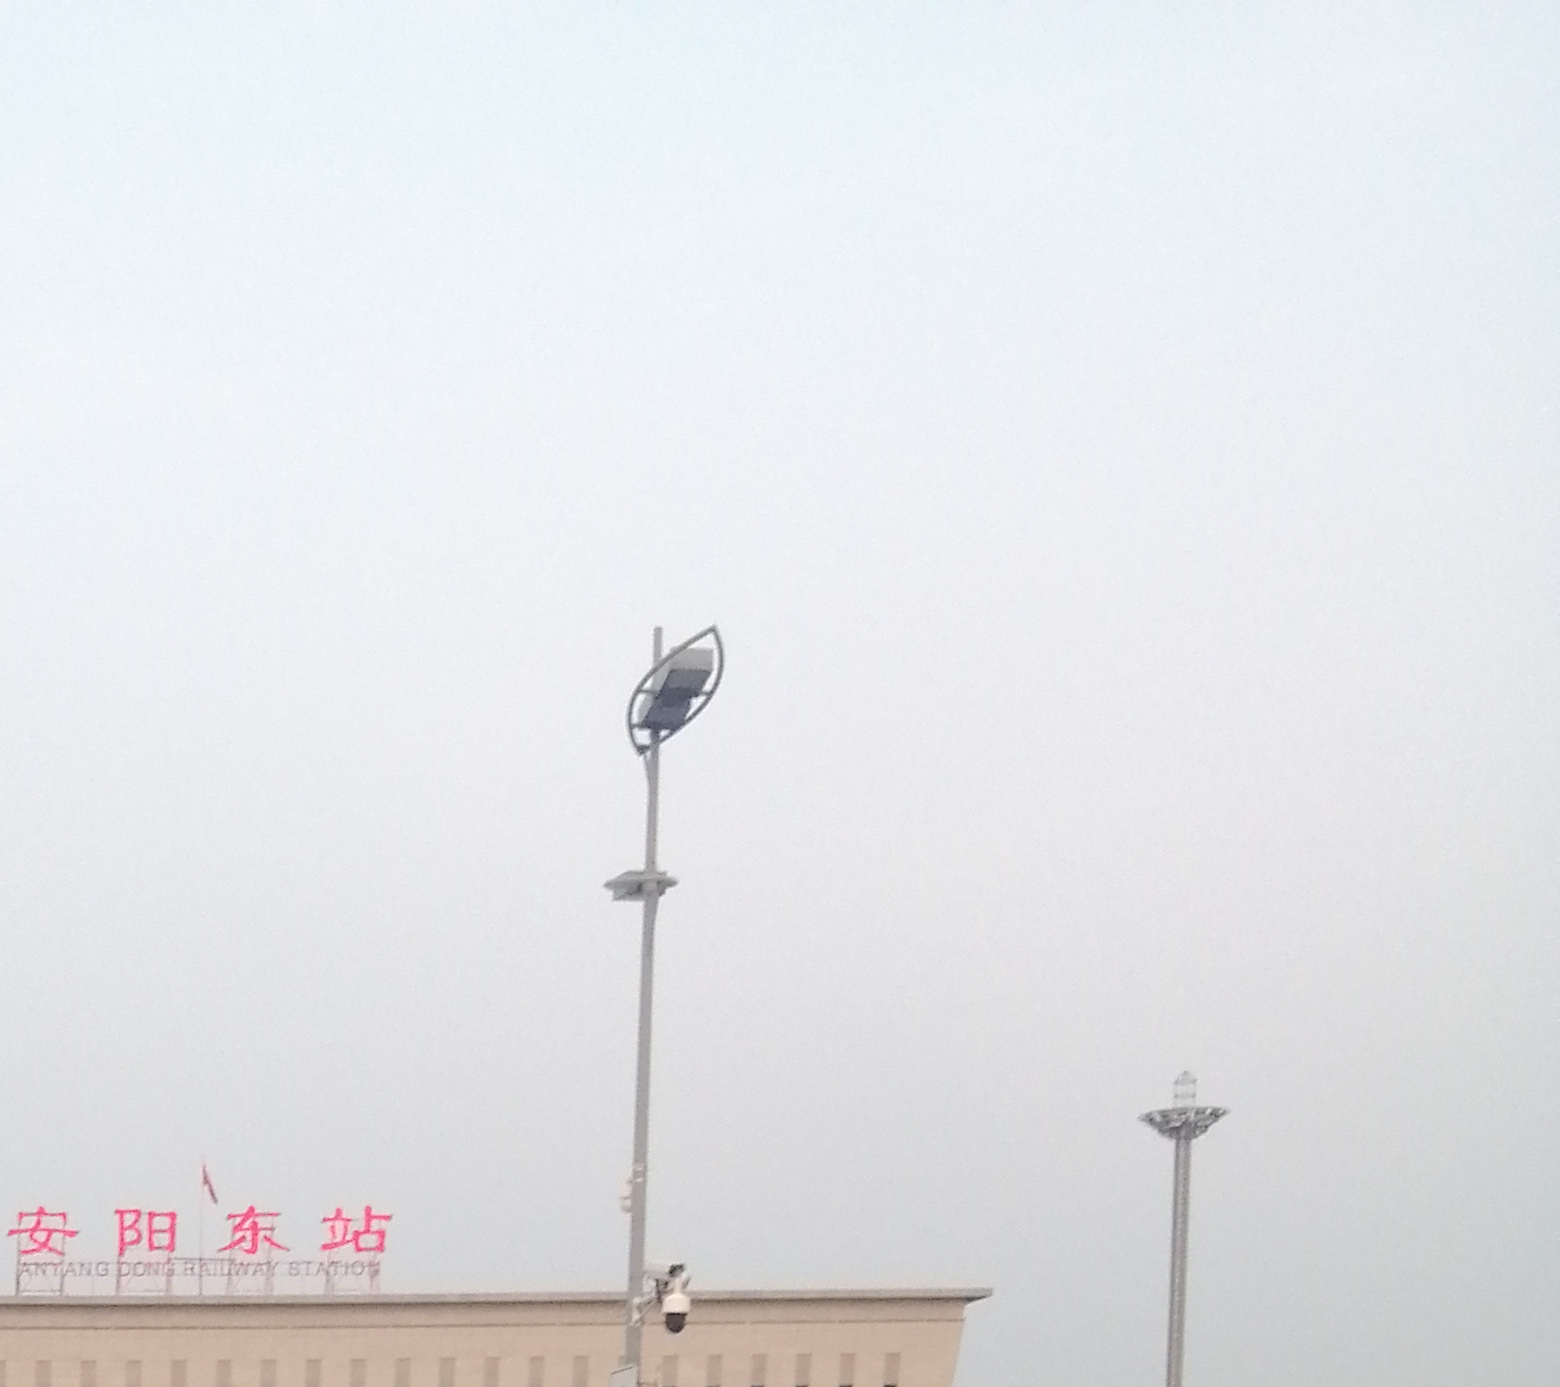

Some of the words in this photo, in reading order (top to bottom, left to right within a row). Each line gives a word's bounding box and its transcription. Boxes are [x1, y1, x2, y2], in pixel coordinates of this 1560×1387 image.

[7, 1205, 393, 1257] 安阳东站
[19, 1261, 109, 1278] ANYANG
[118, 1261, 176, 1278] DONG
[183, 1260, 279, 1278] RAILWAY
[288, 1260, 381, 1278] STATION
